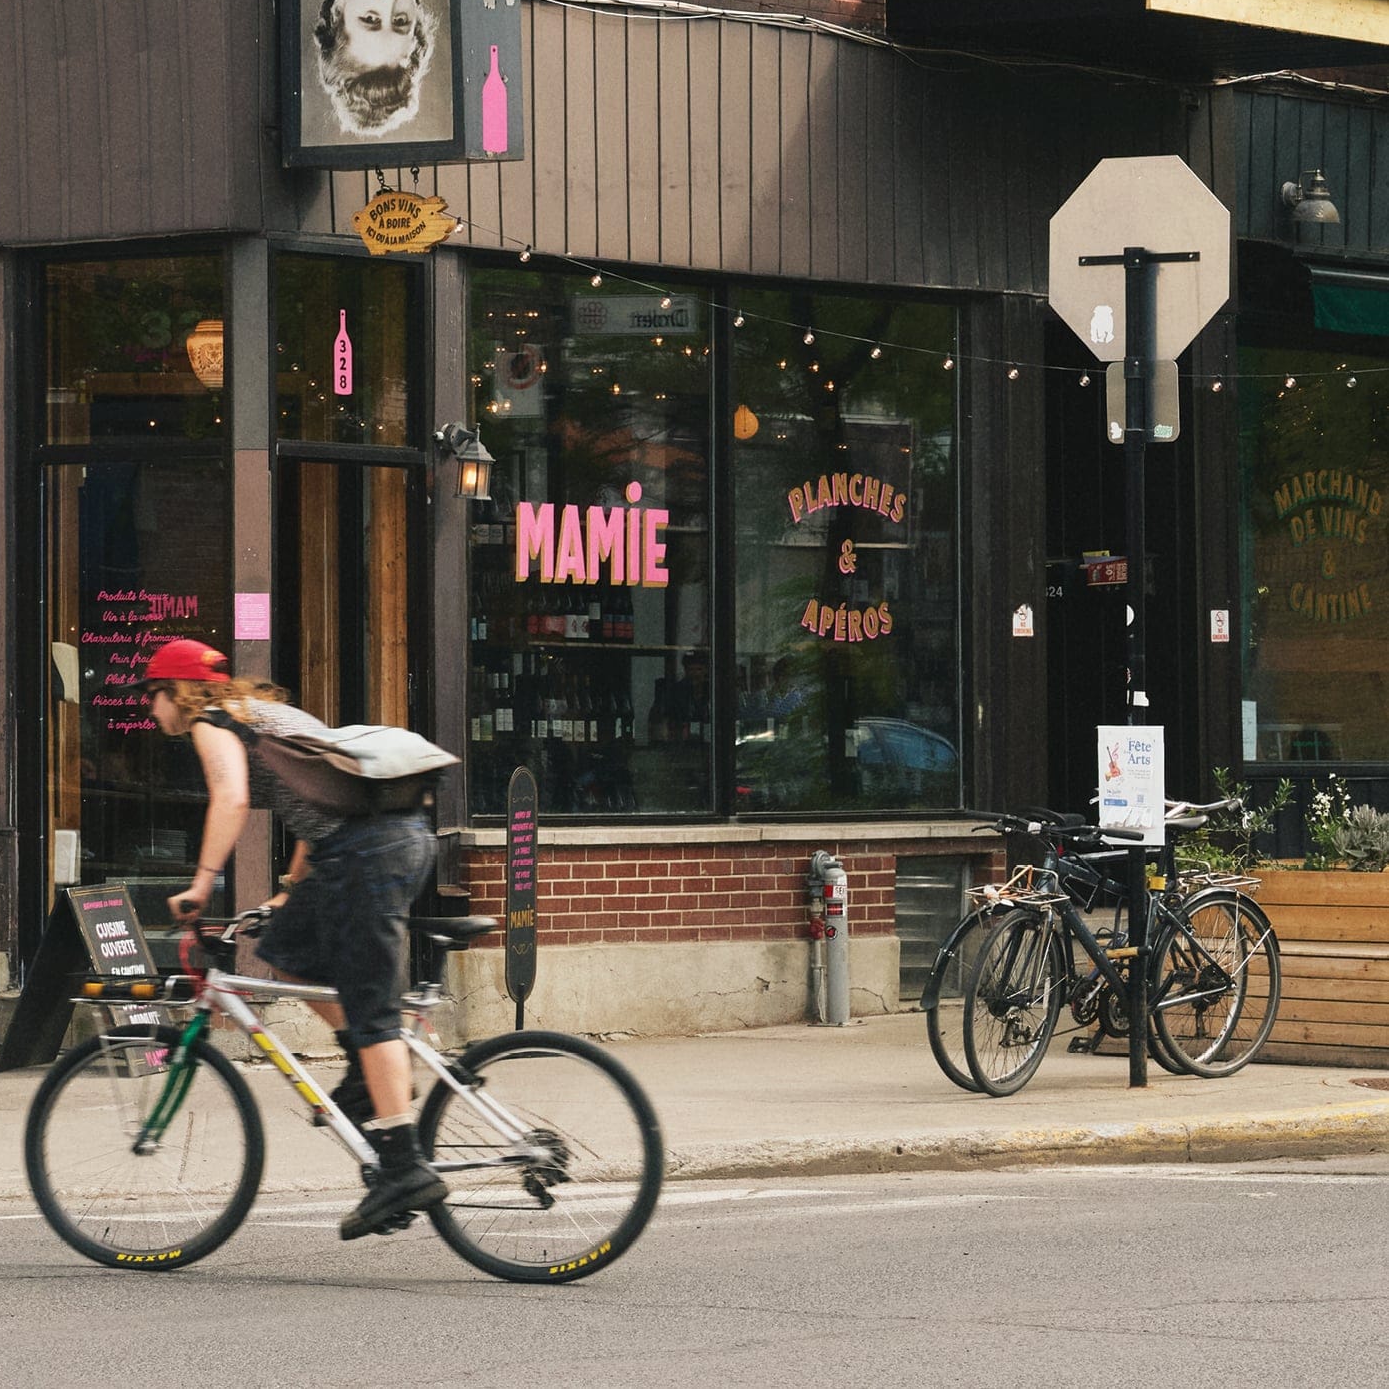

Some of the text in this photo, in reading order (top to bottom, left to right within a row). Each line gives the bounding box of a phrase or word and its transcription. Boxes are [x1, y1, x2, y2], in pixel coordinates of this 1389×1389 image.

[371, 199, 421, 221] BONS VINS
[380, 216, 411, 229] À BOIRE
[367, 227, 377, 239] ICI
[376, 233, 386, 243] OU
[391, 236, 399, 246] LA
[399, 221, 427, 244] MAISON
[788, 472, 907, 524] PLANCHES
[1272, 469, 1383, 520] MARCHAND
[1290, 506, 1368, 547] DE VINS
[838, 538, 857, 574] &
[97, 589, 170, 602] Produits locaux
[1289, 581, 1374, 623] CANTINE
[102, 610, 118, 621] Vin
[119, 611, 127, 621] à
[128, 610, 138, 621] la
[801, 598, 893, 642] APÉROS
[81, 630, 185, 648] Charcuterie & fromages
[110, 652, 129, 664] Pain
[105, 673, 127, 685] Plat
[92, 693, 124, 706] Pièces
[125, 695, 138, 705] du
[115, 718, 158, 735] emporter
[1128, 740, 1152, 753] Fête
[1127, 753, 1152, 766] Arts
[510, 903, 535, 929] MAMIE
[95, 920, 130, 941] CUISINE
[100, 937, 139, 958] OUVERTE
[116, 1248, 182, 1263] MAXXIS
[549, 1239, 611, 1275] MAXXIS
